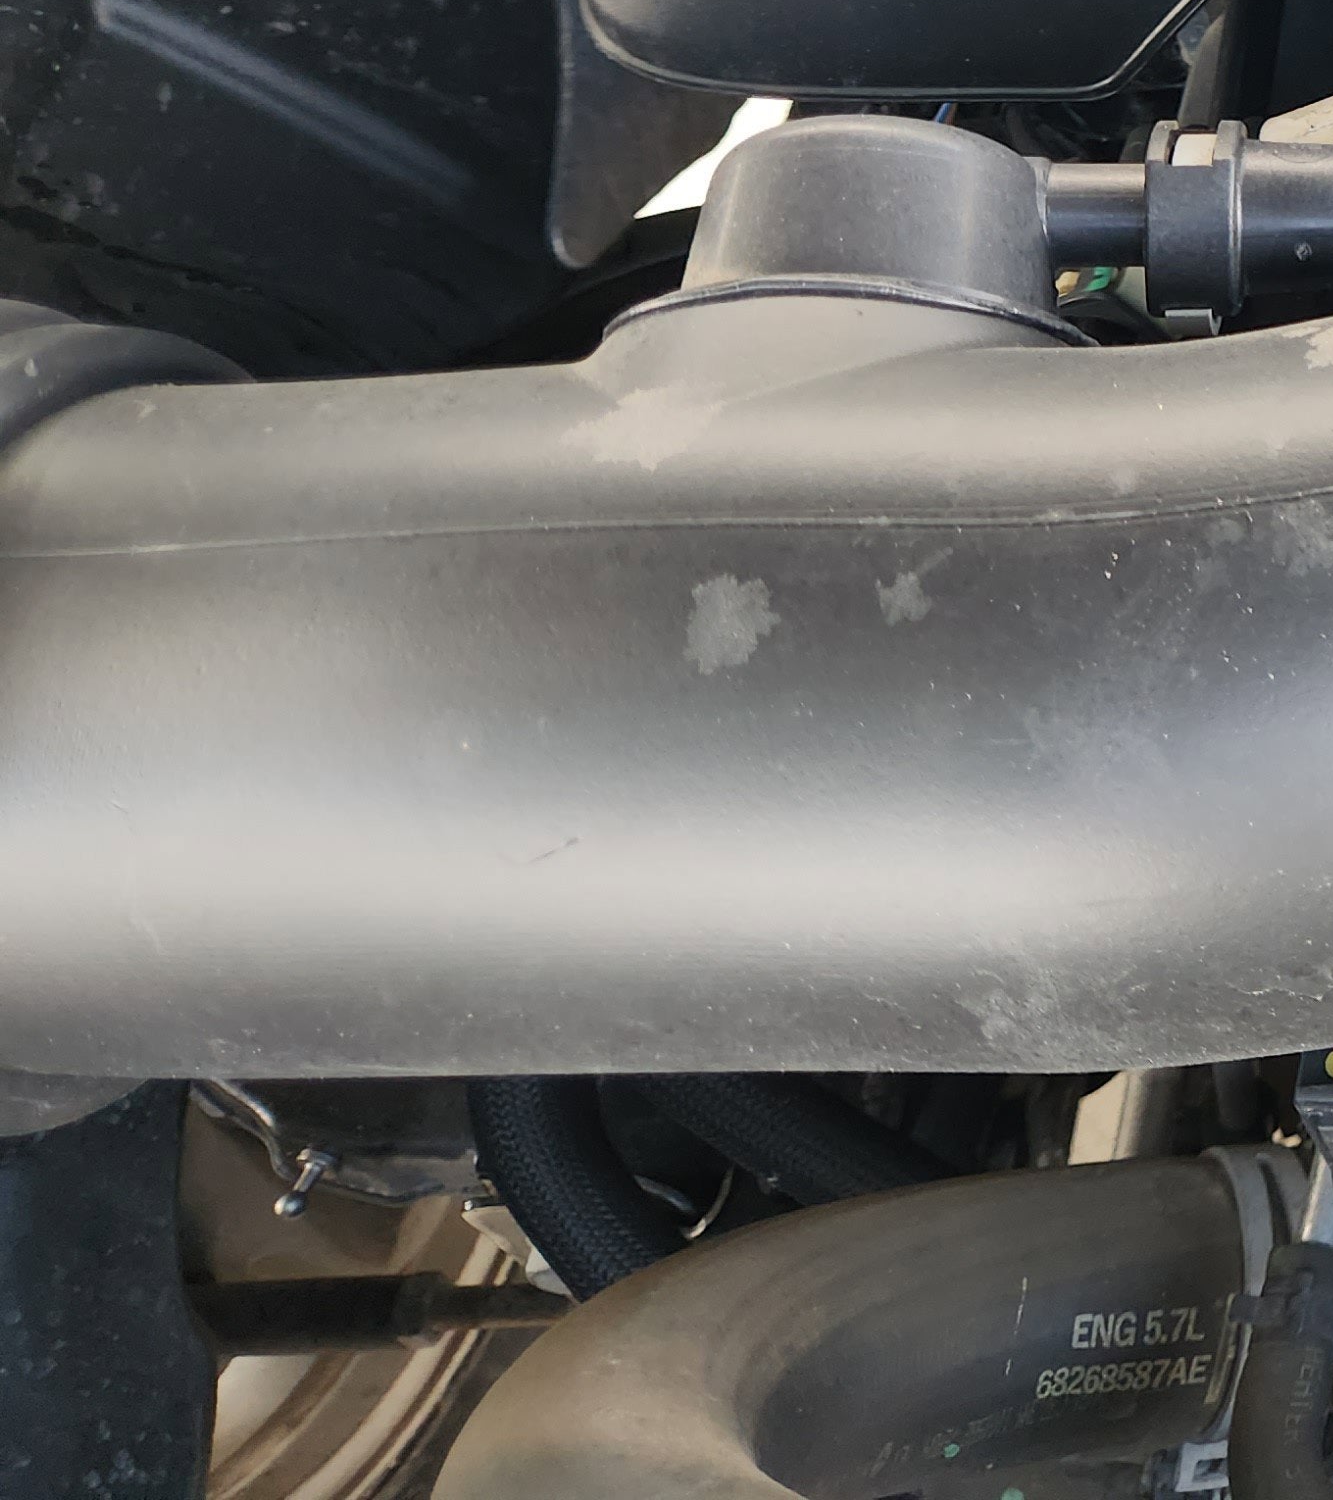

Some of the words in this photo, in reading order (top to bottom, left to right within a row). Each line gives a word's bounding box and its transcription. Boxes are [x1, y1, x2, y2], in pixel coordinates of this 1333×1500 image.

[1071, 1311, 1137, 1349] ENG
[1143, 1306, 1205, 1344] 5.7L
[1035, 1353, 1213, 1400] 68268587AE
